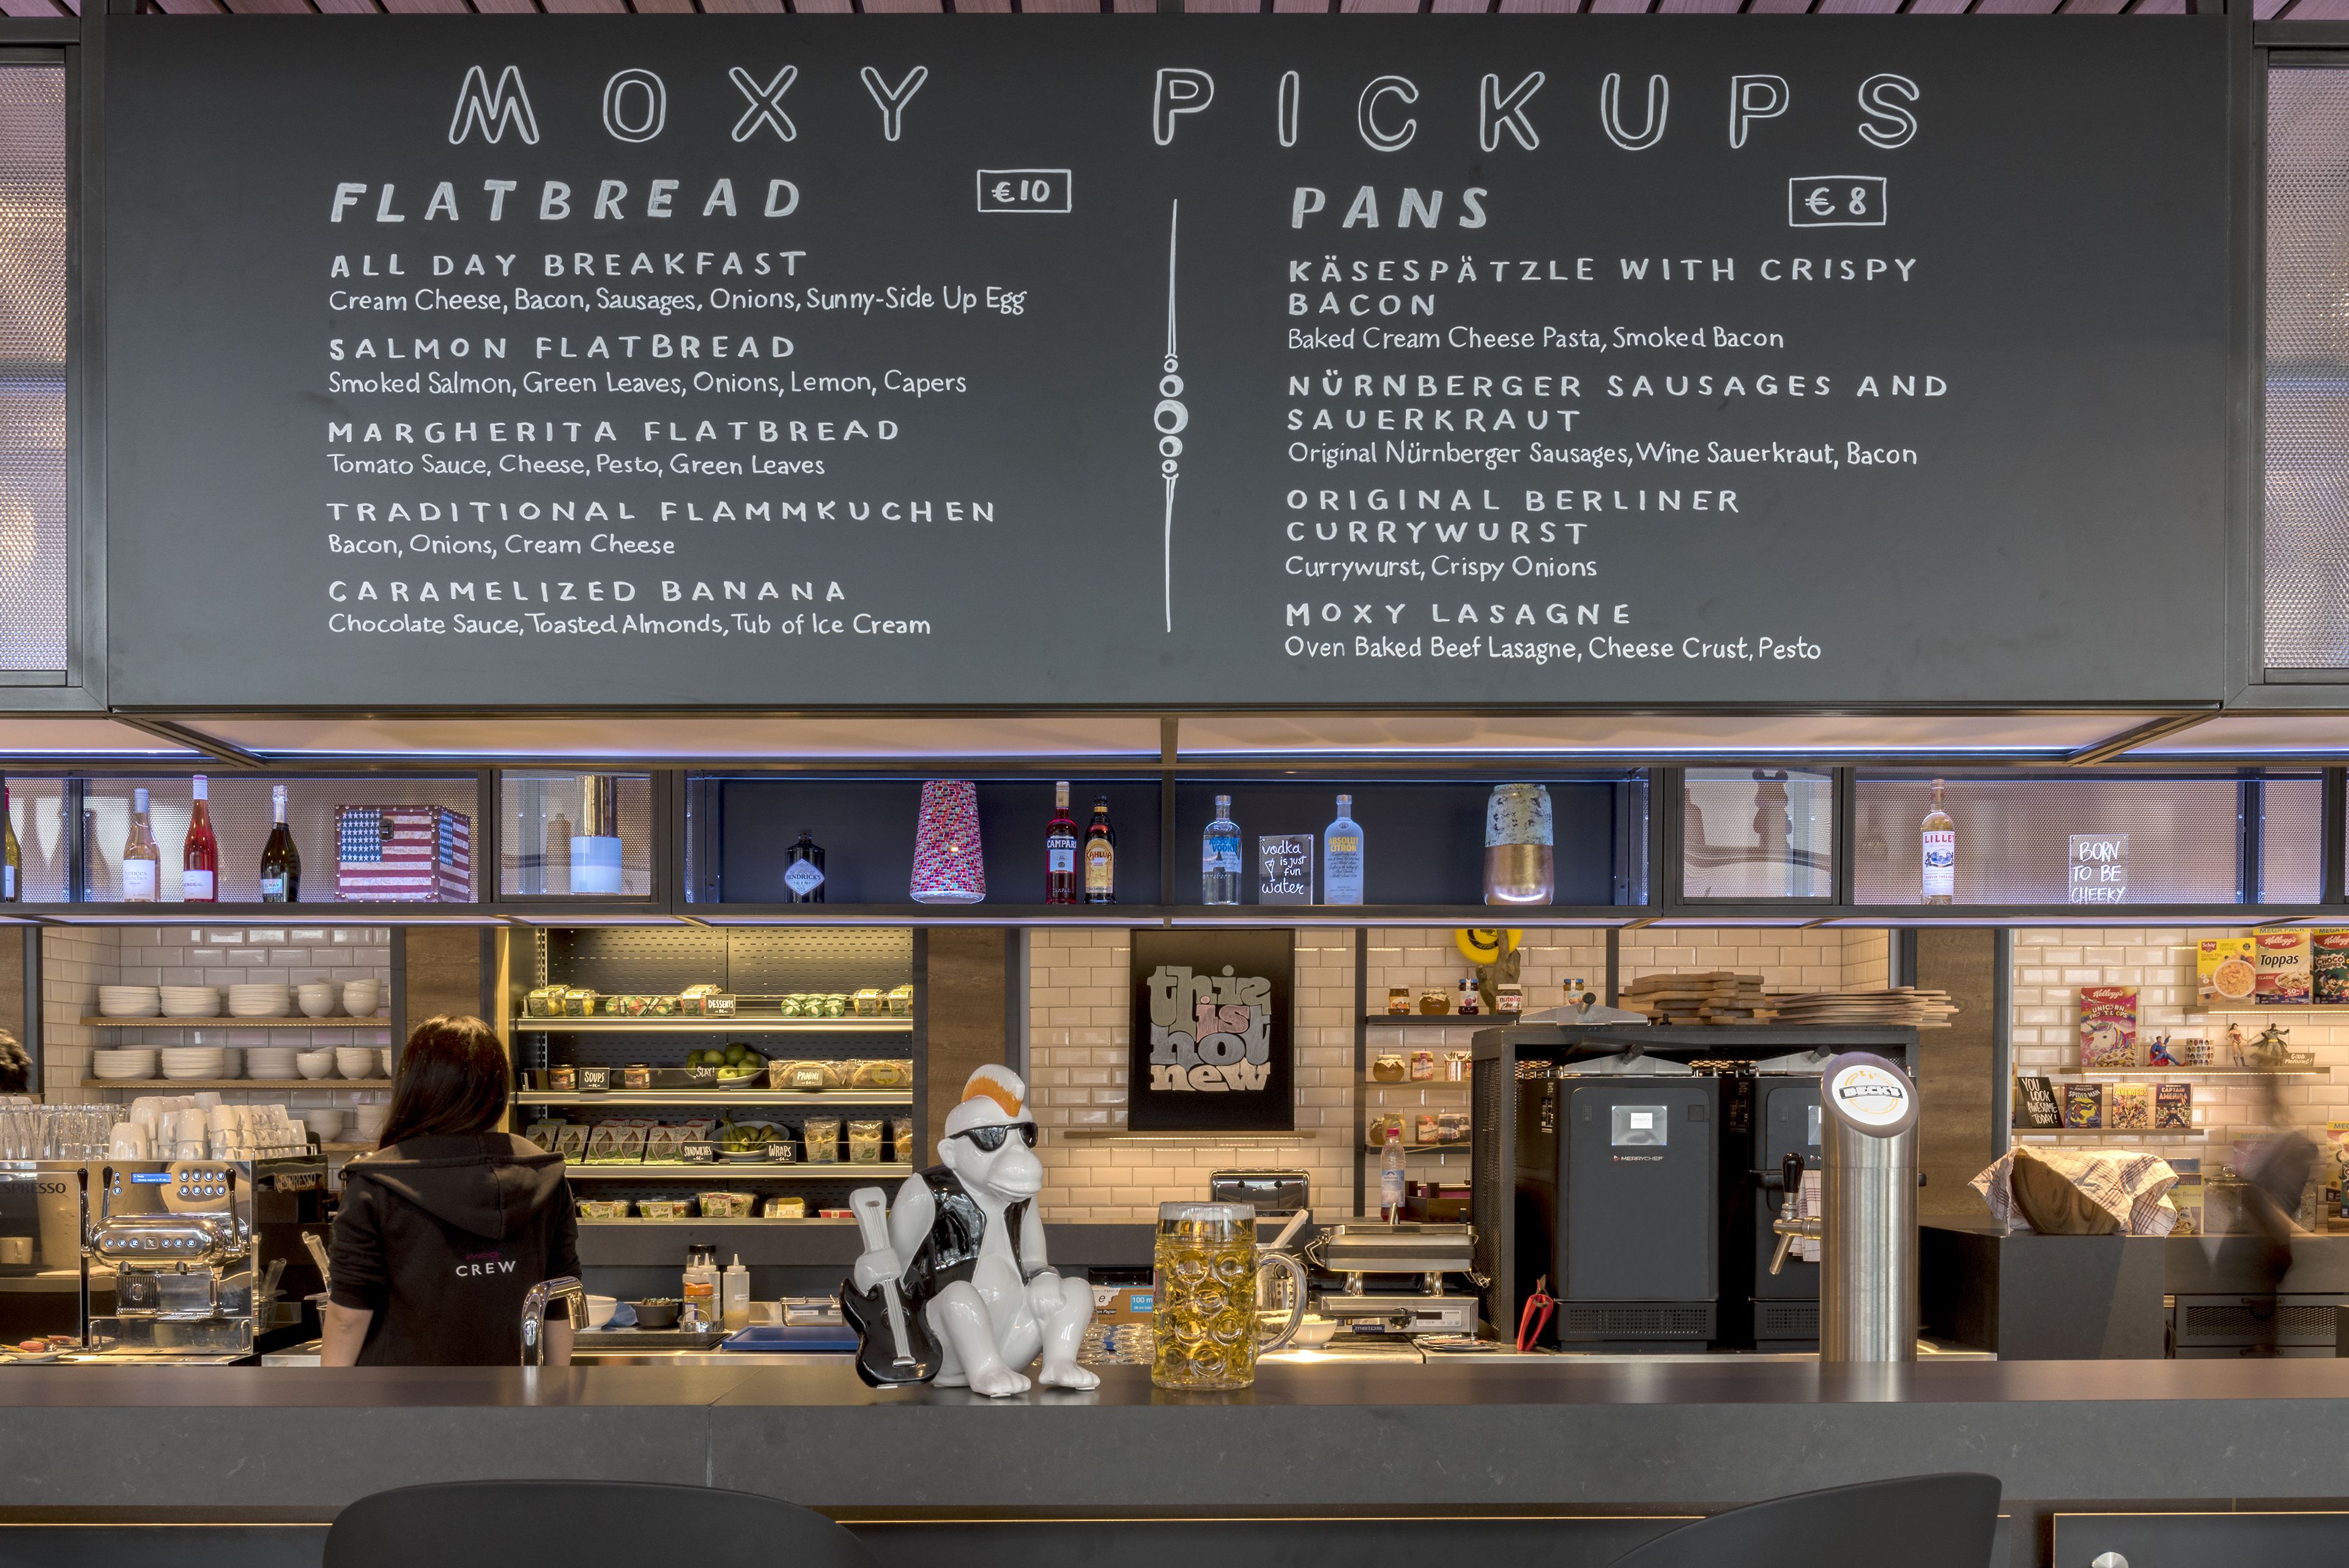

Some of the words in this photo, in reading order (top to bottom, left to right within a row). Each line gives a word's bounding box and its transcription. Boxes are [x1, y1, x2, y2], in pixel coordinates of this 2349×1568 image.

[448, 64, 929, 146] MOXY
[1152, 67, 1920, 153] PICKUPS
[330, 177, 800, 223] FLATBREAD
[991, 179, 1050, 203] €10
[1291, 185, 1488, 229] PANS
[330, 253, 405, 278] ALL
[432, 254, 516, 277] DAY
[544, 250, 807, 277] BREAKFAST
[1289, 255, 1594, 284] KÄSESPÄTZLE
[1620, 257, 1735, 282] WITH
[1760, 258, 1917, 282] CRISPY
[329, 290, 407, 311] Cream
[415, 288, 508, 315] Cheese,
[514, 287, 590, 313] Bacon,
[596, 286, 703, 316] Sausages,
[710, 288, 801, 312] Onions,
[806, 284, 935, 316] Sunny-Side
[943, 285, 978, 314] Up
[986, 286, 1028, 316] Egg
[1288, 291, 1434, 316] BACON
[329, 338, 507, 361] SALMON
[536, 333, 794, 359] FLATBREAD
[1288, 326, 1355, 350] Baked
[1362, 327, 1440, 349] Cream
[1448, 325, 1535, 348] Cheese
[1543, 325, 1608, 354] Pasta,
[1612, 325, 1707, 349] Smoked
[1712, 325, 1784, 349] Bacon
[328, 371, 420, 393] Smoked
[428, 370, 517, 398] Salmon,
[523, 371, 597, 393] Green
[606, 371, 686, 398] Leaves,
[693, 371, 784, 398] Onions,
[791, 370, 877, 396] Lemon,
[884, 369, 967, 398] Capers
[1288, 368, 1581, 398] NÜRNBERGER
[1607, 374, 1830, 398] SAUSAGES
[1856, 374, 1947, 398] AND
[328, 421, 617, 444] MARGHERITA
[644, 420, 899, 442] FLATBREAD
[1287, 408, 1581, 433] SAUERKRAUT
[326, 453, 414, 475] Tomato
[421, 453, 491, 477] Sauce,
[499, 454, 590, 477] Cheese,
[596, 453, 663, 478] Pesto,
[669, 453, 743, 475] Green
[752, 455, 825, 475] Leaves
[1288, 441, 1378, 469] Original
[1386, 439, 1521, 470] Nürnberger
[1529, 442, 1633, 469] Sausages,
[1636, 440, 1700, 464] Wine
[1707, 441, 1839, 470] Sauerkraut,
[1847, 440, 1917, 466] Bacon
[325, 500, 636, 523] TRADITIONAL
[661, 500, 993, 523] FLAMMKUCHEN
[1286, 489, 1500, 511] ORIGINAL
[1526, 489, 1739, 513] BERLINER
[1286, 520, 1588, 545] CURRYWURST
[328, 533, 403, 559] Bacon,
[409, 533, 497, 560] Onions,
[505, 534, 581, 554] Cream
[590, 533, 675, 555] Cheese
[1285, 555, 1425, 582] Currywurst,
[1431, 554, 1505, 582] Crispy
[1512, 555, 1597, 578] Onions
[328, 580, 636, 603] CARAMELIZED
[661, 581, 845, 602] BANANA
[328, 613, 446, 634] Chocolate
[453, 614, 524, 636] Sauce,
[524, 612, 618, 635] Toasted
[622, 612, 729, 637] Almonds,
[730, 613, 771, 634] Tub
[781, 613, 805, 635] of
[812, 612, 844, 634] Ice
[853, 613, 930, 634] Cream
[1286, 603, 1406, 627] MOXY
[1432, 603, 1630, 625] LASAGNE
[1285, 635, 1345, 658] Oven
[1355, 636, 1422, 658] Baked
[1431, 636, 1482, 658] Beef
[1488, 636, 1583, 666] Lasagne,
[1589, 636, 1675, 660] Cheese
[1682, 636, 1754, 661] Crust,
[1759, 636, 1822, 660] Pesto
[1047, 839, 1077, 849] CAMPARI
[1209, 837, 1239, 845] ABSOLUT
[1262, 840, 1302, 855] vodka
[2080, 841, 2120, 862] BORN
[1280, 856, 1287, 866] is
[1288, 855, 1307, 868] just
[1285, 868, 1301, 876] fun
[2072, 865, 2092, 882] TO
[2101, 864, 2121, 882] BE
[1261, 878, 1304, 894] water
[2071, 886, 2126, 904] CHEEKY
[2265, 935, 2298, 946] Kellogg's
[2324, 935, 2349, 946] Kellogg
[2260, 954, 2299, 968] Toppas
[2316, 956, 2344, 965] CHOCO
[708, 999, 733, 1009] DESSERTS
[1147, 965, 1271, 1041] this
[2093, 989, 2124, 999] Kellogg's
[1196, 995, 1250, 1043] is
[2092, 1005, 2124, 1013] UNICORN
[584, 1071, 604, 1083] SOUPS
[696, 1066, 714, 1077] SLAY!
[1150, 1057, 1271, 1091] new
[2021, 1077, 2040, 1091] YOU
[2068, 1089, 2101, 1099] SPIDER-MAN
[2115, 1087, 2148, 1096] AVENGERS
[2027, 1101, 2058, 1113] AWESOME
[2030, 1090, 2050, 1102] LOOK
[2032, 1113, 2058, 1124] TODAY!
[684, 1145, 712, 1157] SANDWICHES
[768, 1143, 792, 1157] WRAPS
[456, 1261, 516, 1277] CREW
